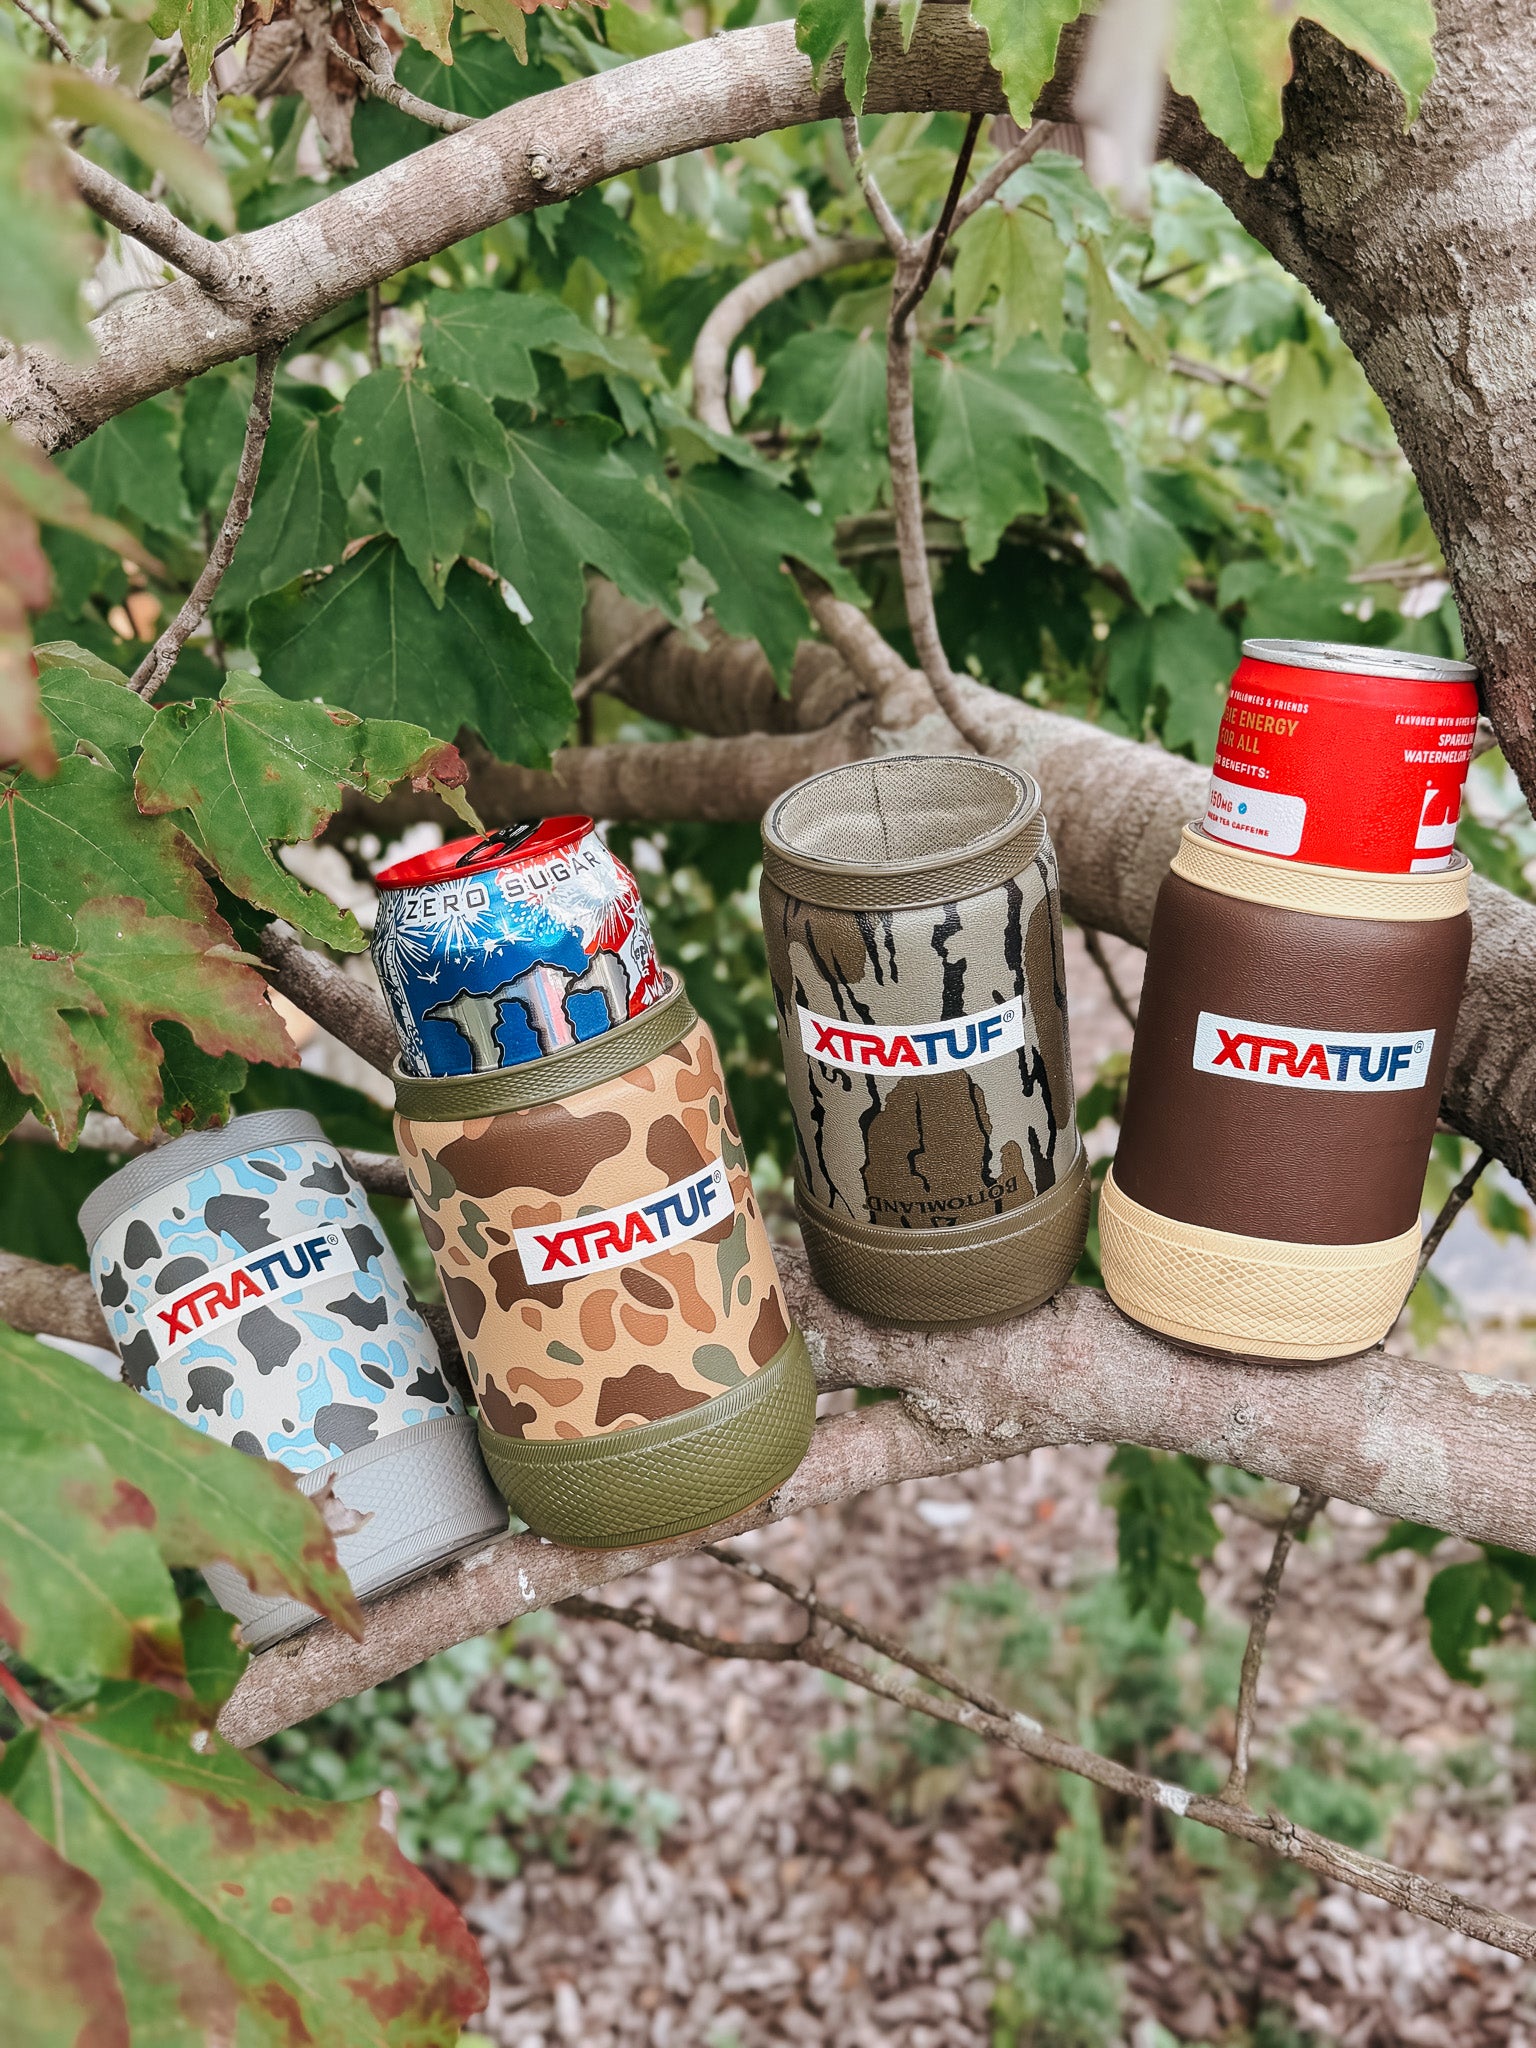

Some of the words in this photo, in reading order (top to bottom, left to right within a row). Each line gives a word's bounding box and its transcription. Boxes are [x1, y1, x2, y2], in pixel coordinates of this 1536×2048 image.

[1265, 698, 1273, 708] &
[1274, 700, 1310, 714] FRIENDS
[1239, 710, 1300, 737] ENERGY
[1395, 714, 1436, 727] FLAVORED
[1437, 717, 1454, 727] WITH
[1236, 733, 1260, 755] ALL
[1221, 756, 1270, 779] BENEFITS:
[1404, 749, 1467, 764] WATERMELON
[1231, 821, 1270, 837] CAFFEINE
[406, 887, 486, 920] ZERO
[505, 850, 602, 898] SUGAR
[866, 1175, 1018, 1214] BOTTOMLAND
